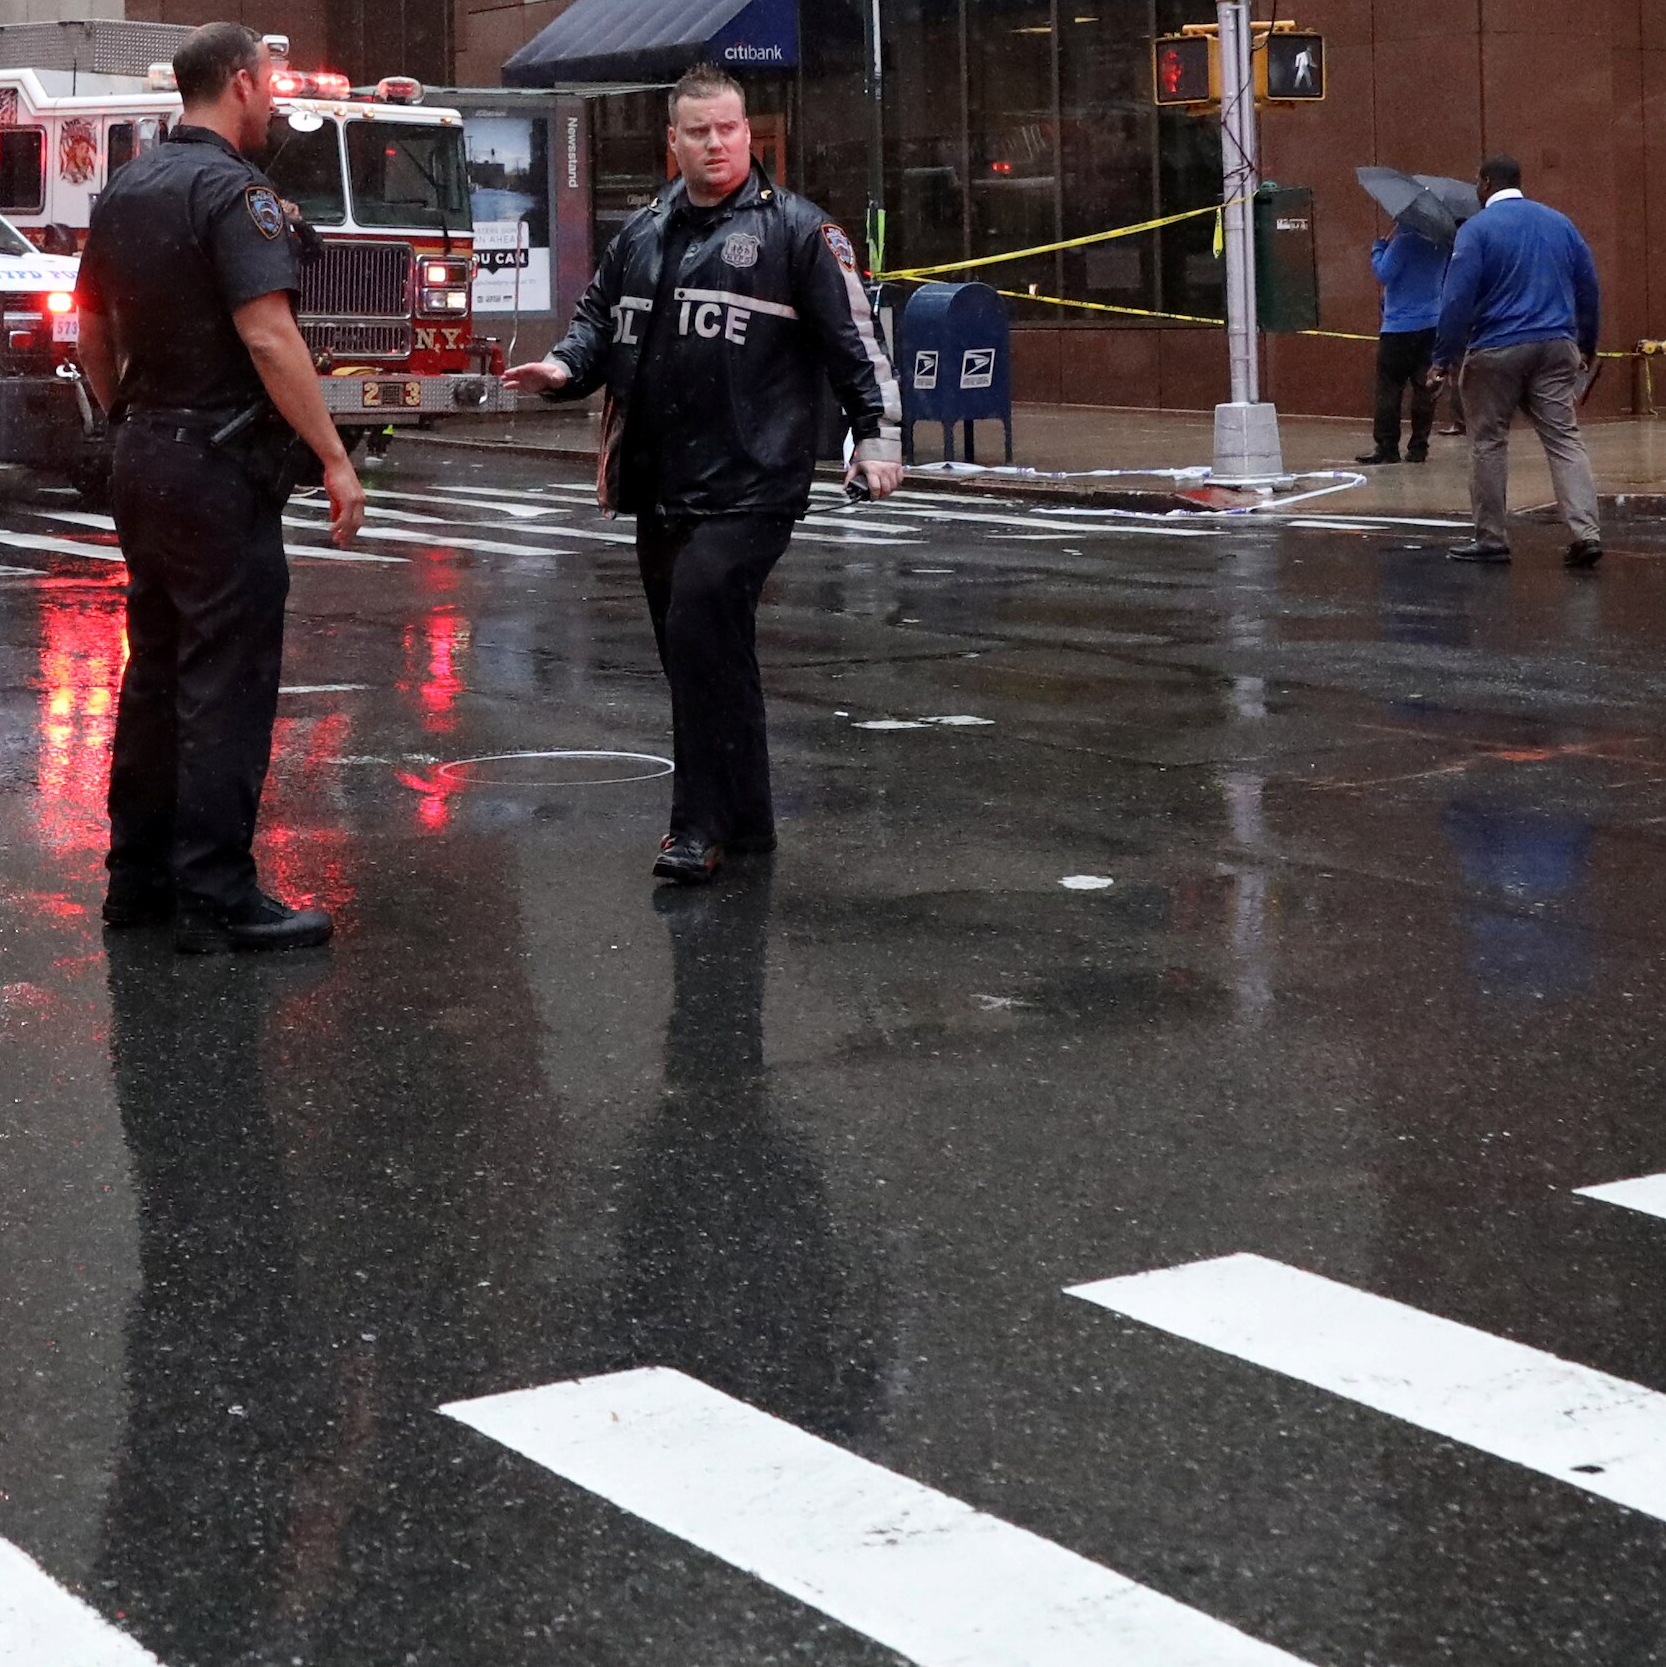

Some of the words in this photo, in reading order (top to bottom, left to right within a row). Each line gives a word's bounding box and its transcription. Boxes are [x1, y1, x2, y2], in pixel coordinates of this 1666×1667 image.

[724, 42, 783, 60] citibank
[567, 117, 579, 188] Newsstand
[414, 327, 465, 353] N.Y.
